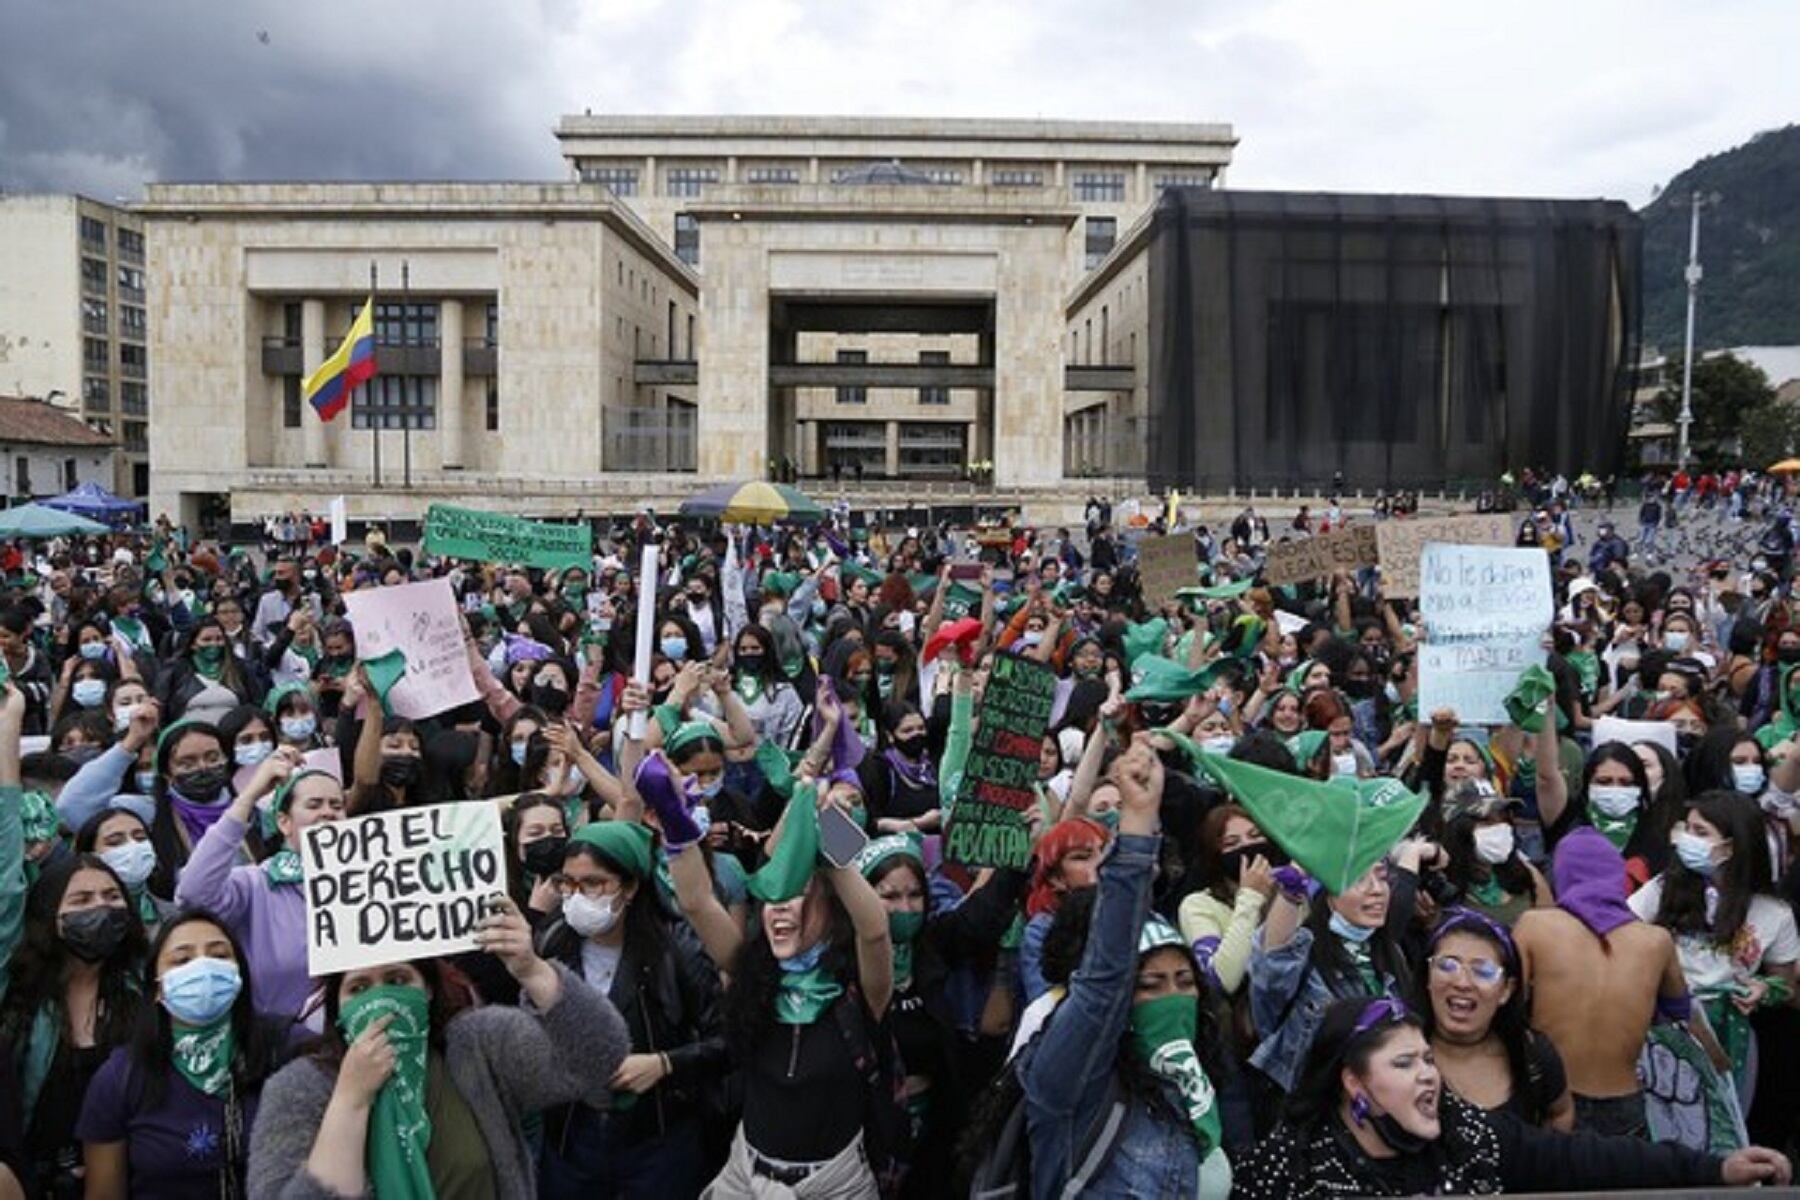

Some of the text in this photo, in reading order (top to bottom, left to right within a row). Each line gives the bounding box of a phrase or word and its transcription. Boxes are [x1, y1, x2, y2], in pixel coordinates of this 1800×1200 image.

[486, 546, 532, 561] SOCIAL
[1274, 555, 1327, 580] LEGAL
[1426, 552, 1452, 586] No
[307, 809, 453, 869] POR EL
[945, 822, 1032, 870] ABORTAN
[309, 848, 497, 908] DERECHO
[316, 890, 505, 947] A DECIDI
